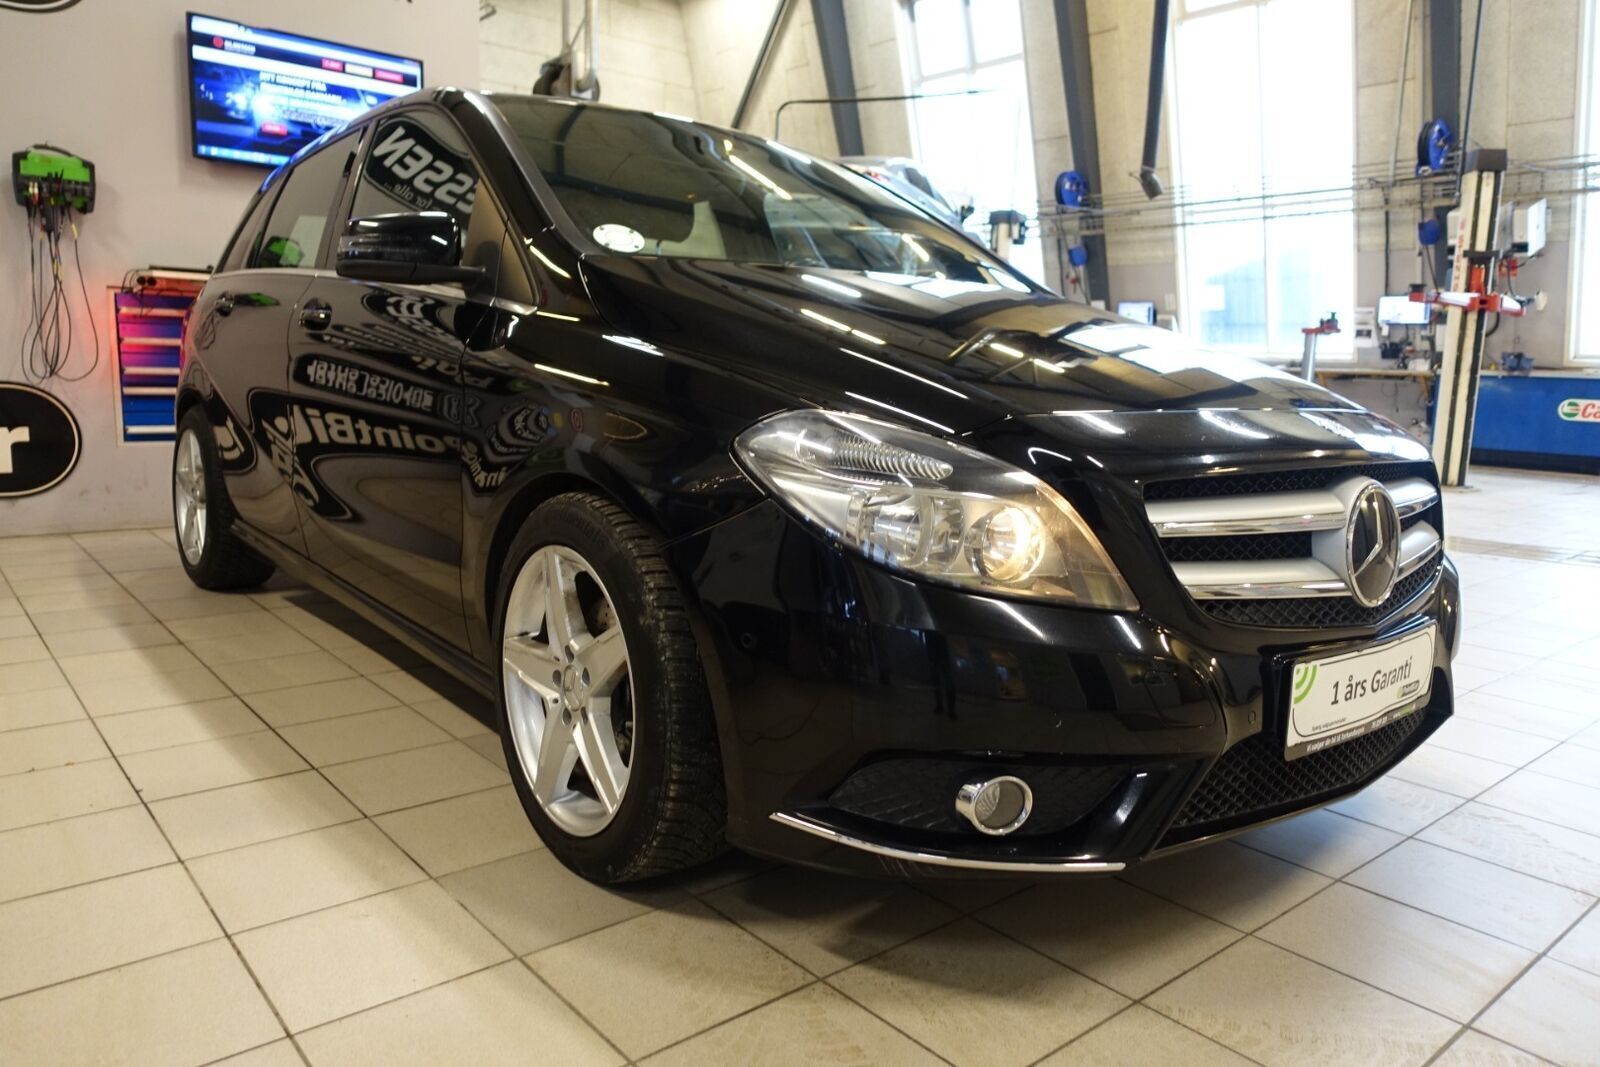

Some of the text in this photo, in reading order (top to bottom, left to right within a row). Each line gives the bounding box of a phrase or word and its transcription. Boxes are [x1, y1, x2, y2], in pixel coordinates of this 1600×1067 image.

[1331, 680, 1340, 706] 1
[1344, 674, 1367, 702] års
[1370, 655, 1413, 693] Garanti
